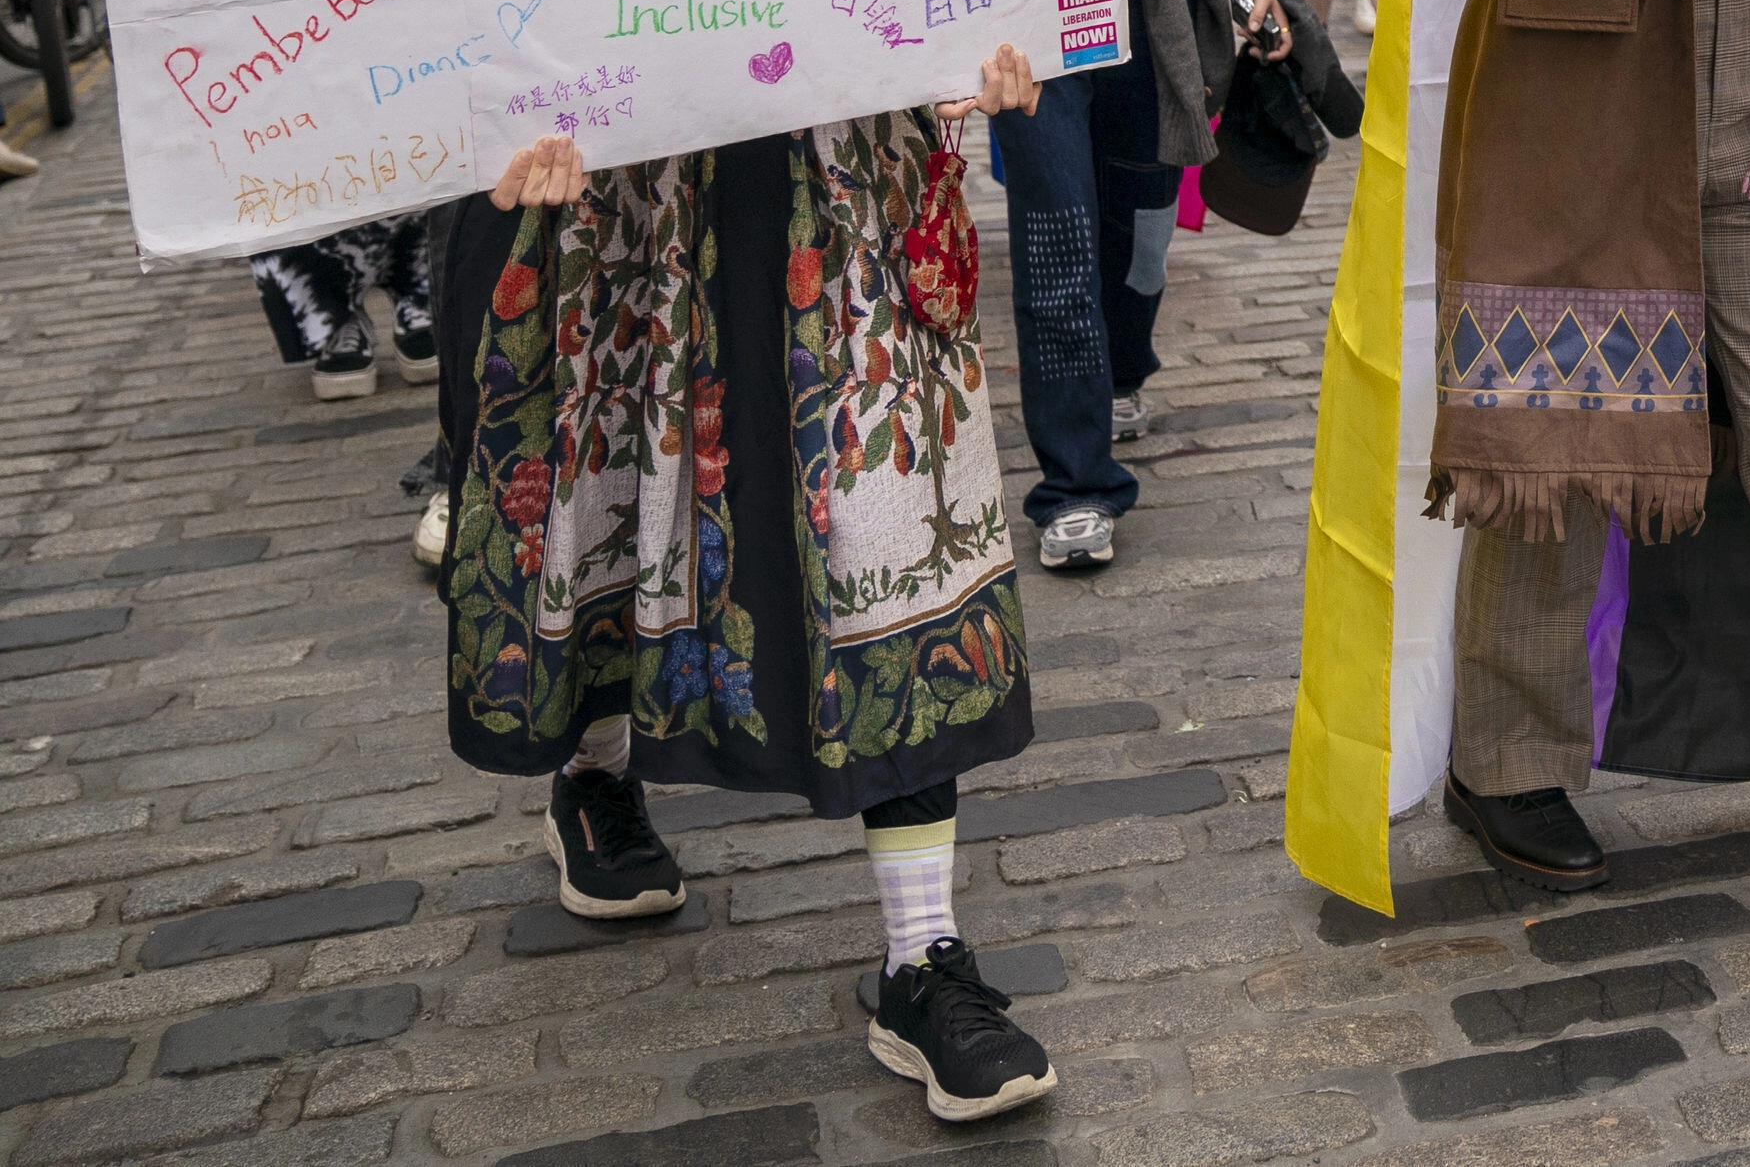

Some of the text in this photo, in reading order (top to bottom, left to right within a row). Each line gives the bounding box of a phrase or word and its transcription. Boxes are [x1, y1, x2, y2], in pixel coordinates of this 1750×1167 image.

[1062, 8, 1112, 26] LIBERATION
[1063, 25, 1115, 50] NOW!
[505, 65, 642, 115] 你是你或是妳
[555, 104, 611, 139] 都行
